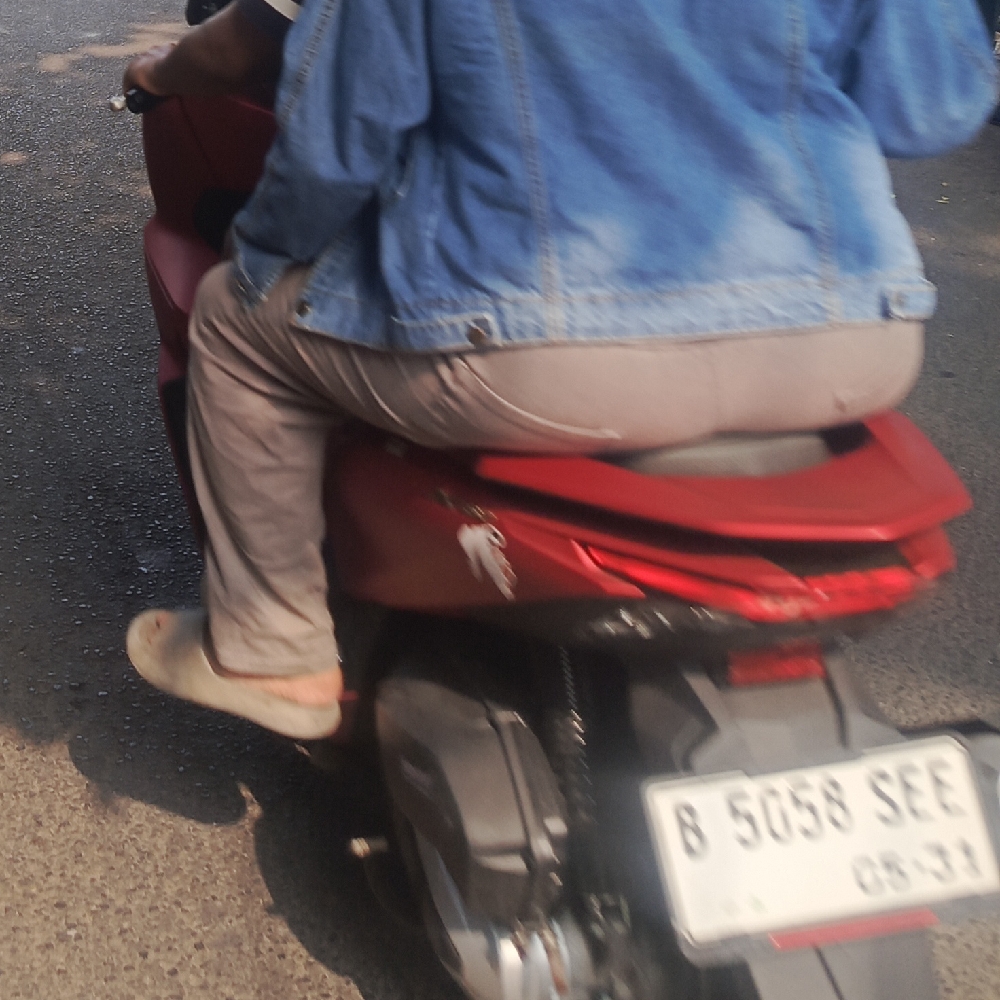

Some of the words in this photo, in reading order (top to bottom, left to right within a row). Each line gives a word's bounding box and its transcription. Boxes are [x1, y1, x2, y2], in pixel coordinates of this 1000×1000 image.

[673, 801, 708, 859] B
[724, 774, 852, 849] 5058
[867, 757, 967, 827] SEE
